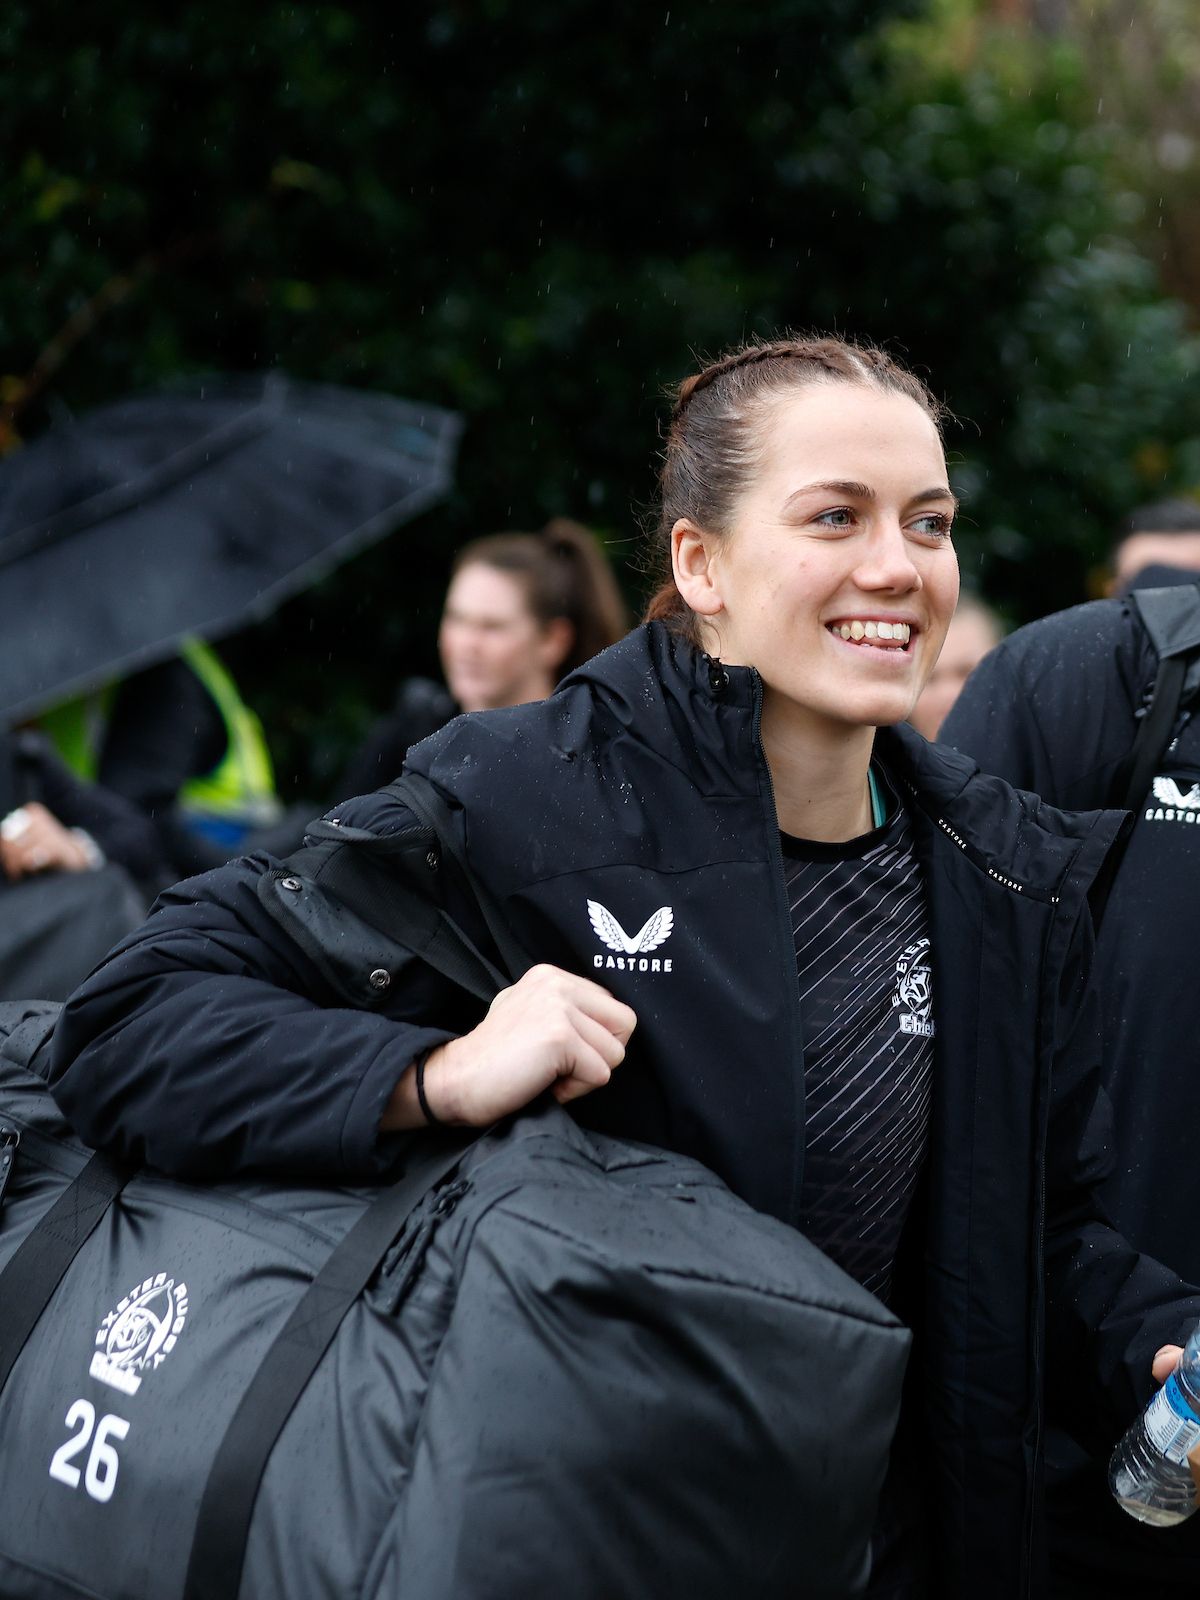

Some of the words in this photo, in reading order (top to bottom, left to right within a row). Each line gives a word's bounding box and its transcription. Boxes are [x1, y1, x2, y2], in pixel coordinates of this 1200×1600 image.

[938, 819, 967, 849] CASTORE
[988, 868, 1023, 891] CASTORE
[593, 954, 673, 972] CASTORE
[899, 1013, 935, 1038] Chie
[95, 1272, 167, 1346] EXETER
[49, 1398, 131, 1503] 26
